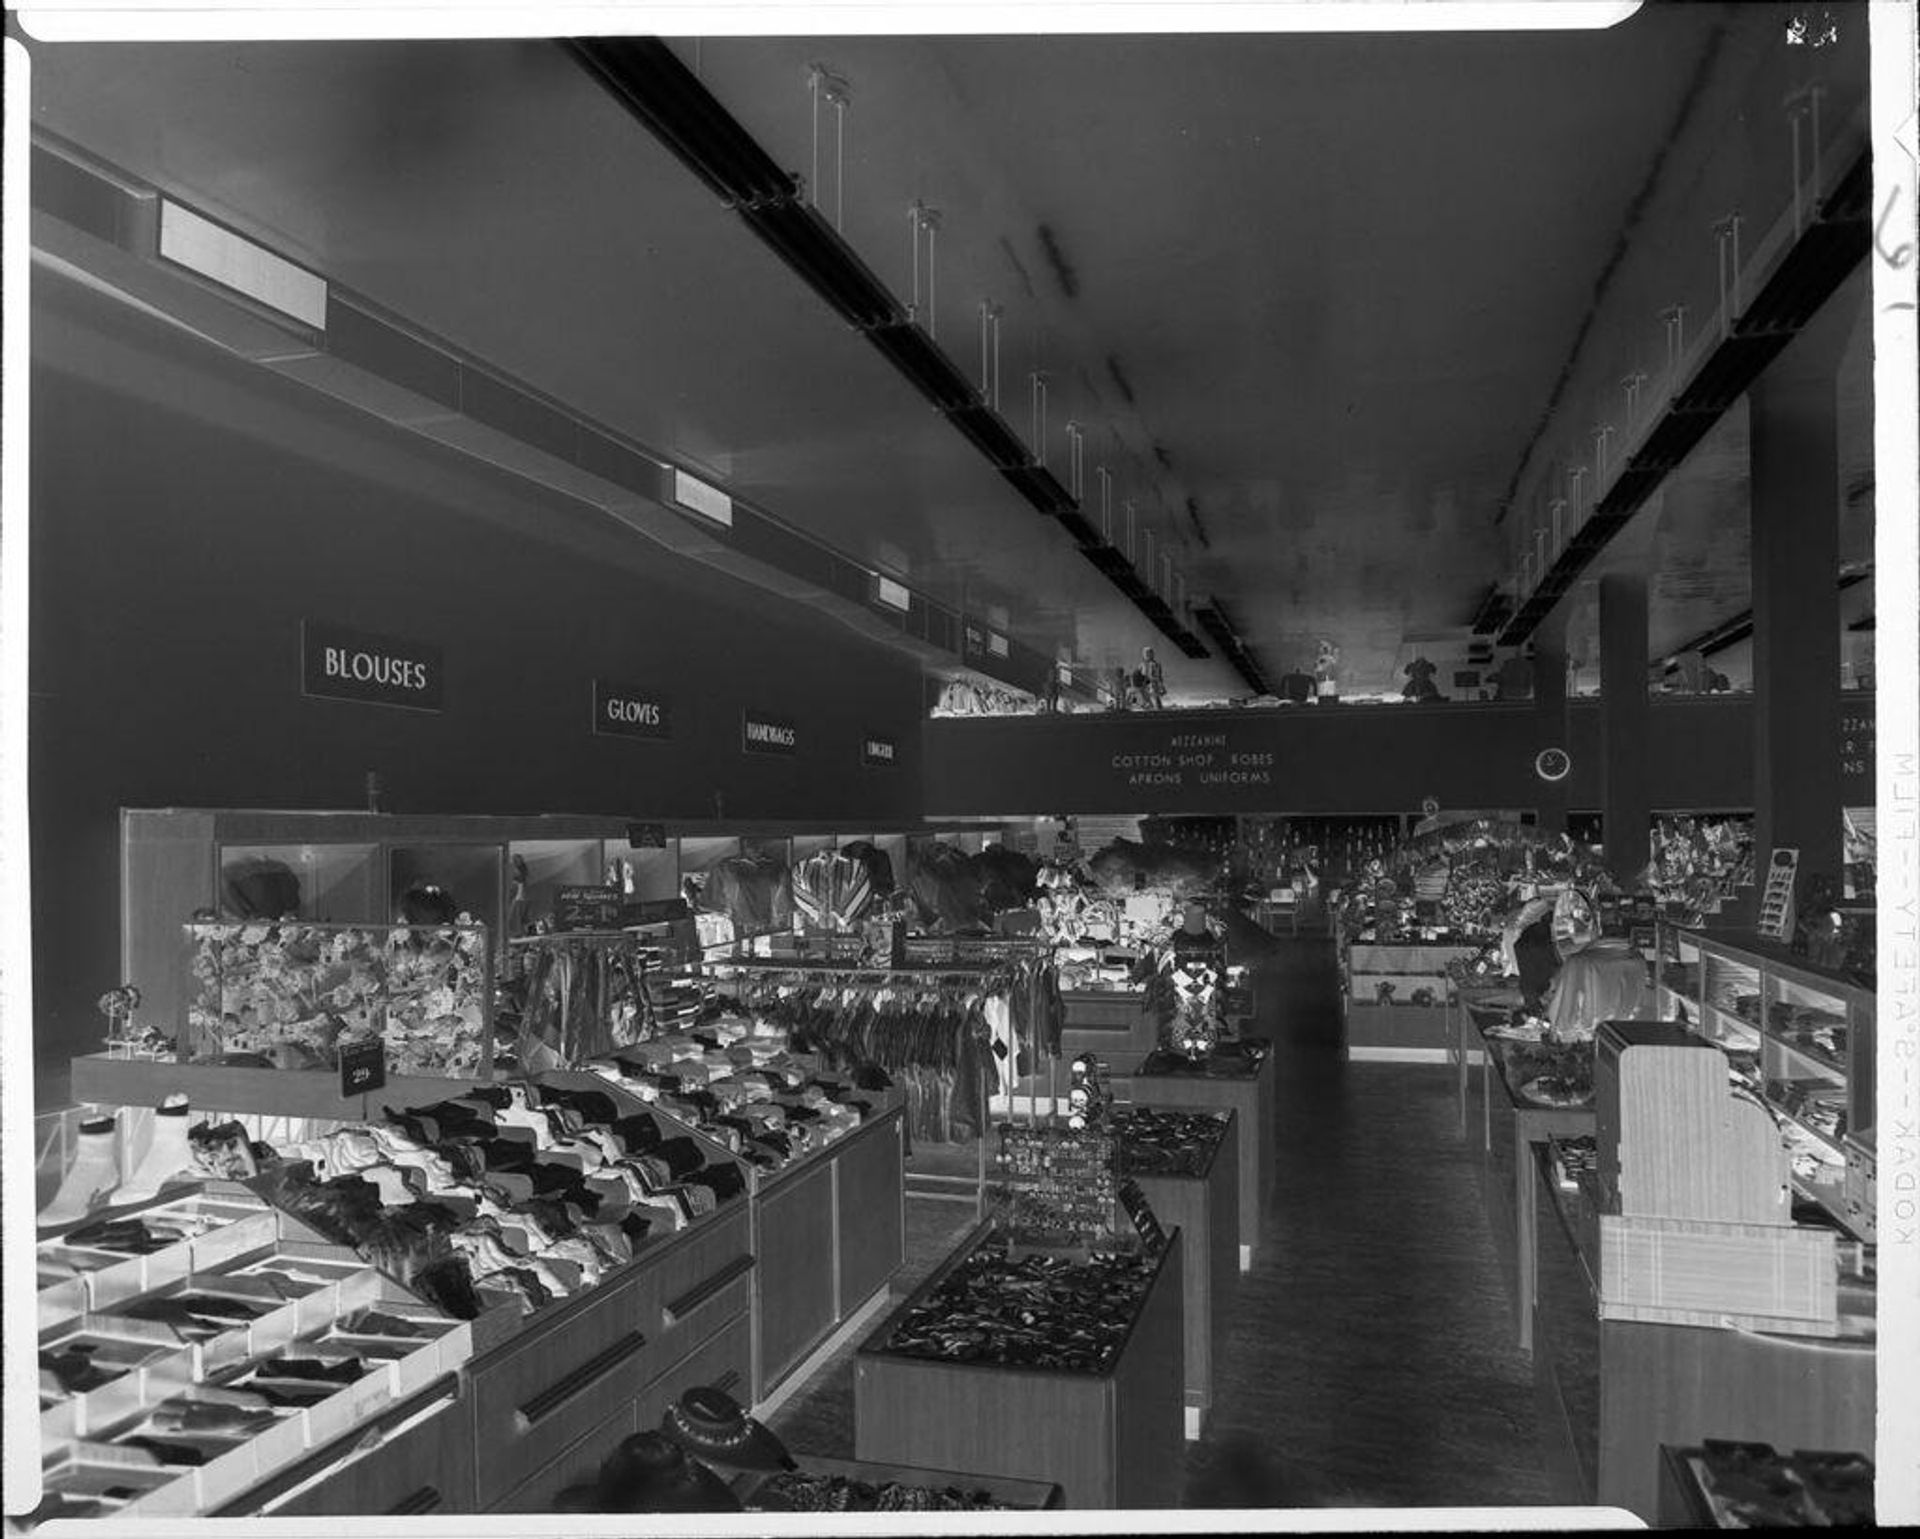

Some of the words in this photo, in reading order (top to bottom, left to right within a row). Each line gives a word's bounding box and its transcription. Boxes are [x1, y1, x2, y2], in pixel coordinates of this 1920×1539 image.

[325, 647, 426, 690] BLOUSES
[607, 699, 660, 725] GLOVES
[746, 719, 795, 746] HANDBAGS
[1112, 755, 1171, 768] COTTON
[1179, 754, 1213, 766] SHOP
[1232, 753, 1274, 766] ROBES
[1129, 772, 1181, 784] APRONS
[1200, 772, 1272, 784] UNIFORMS
